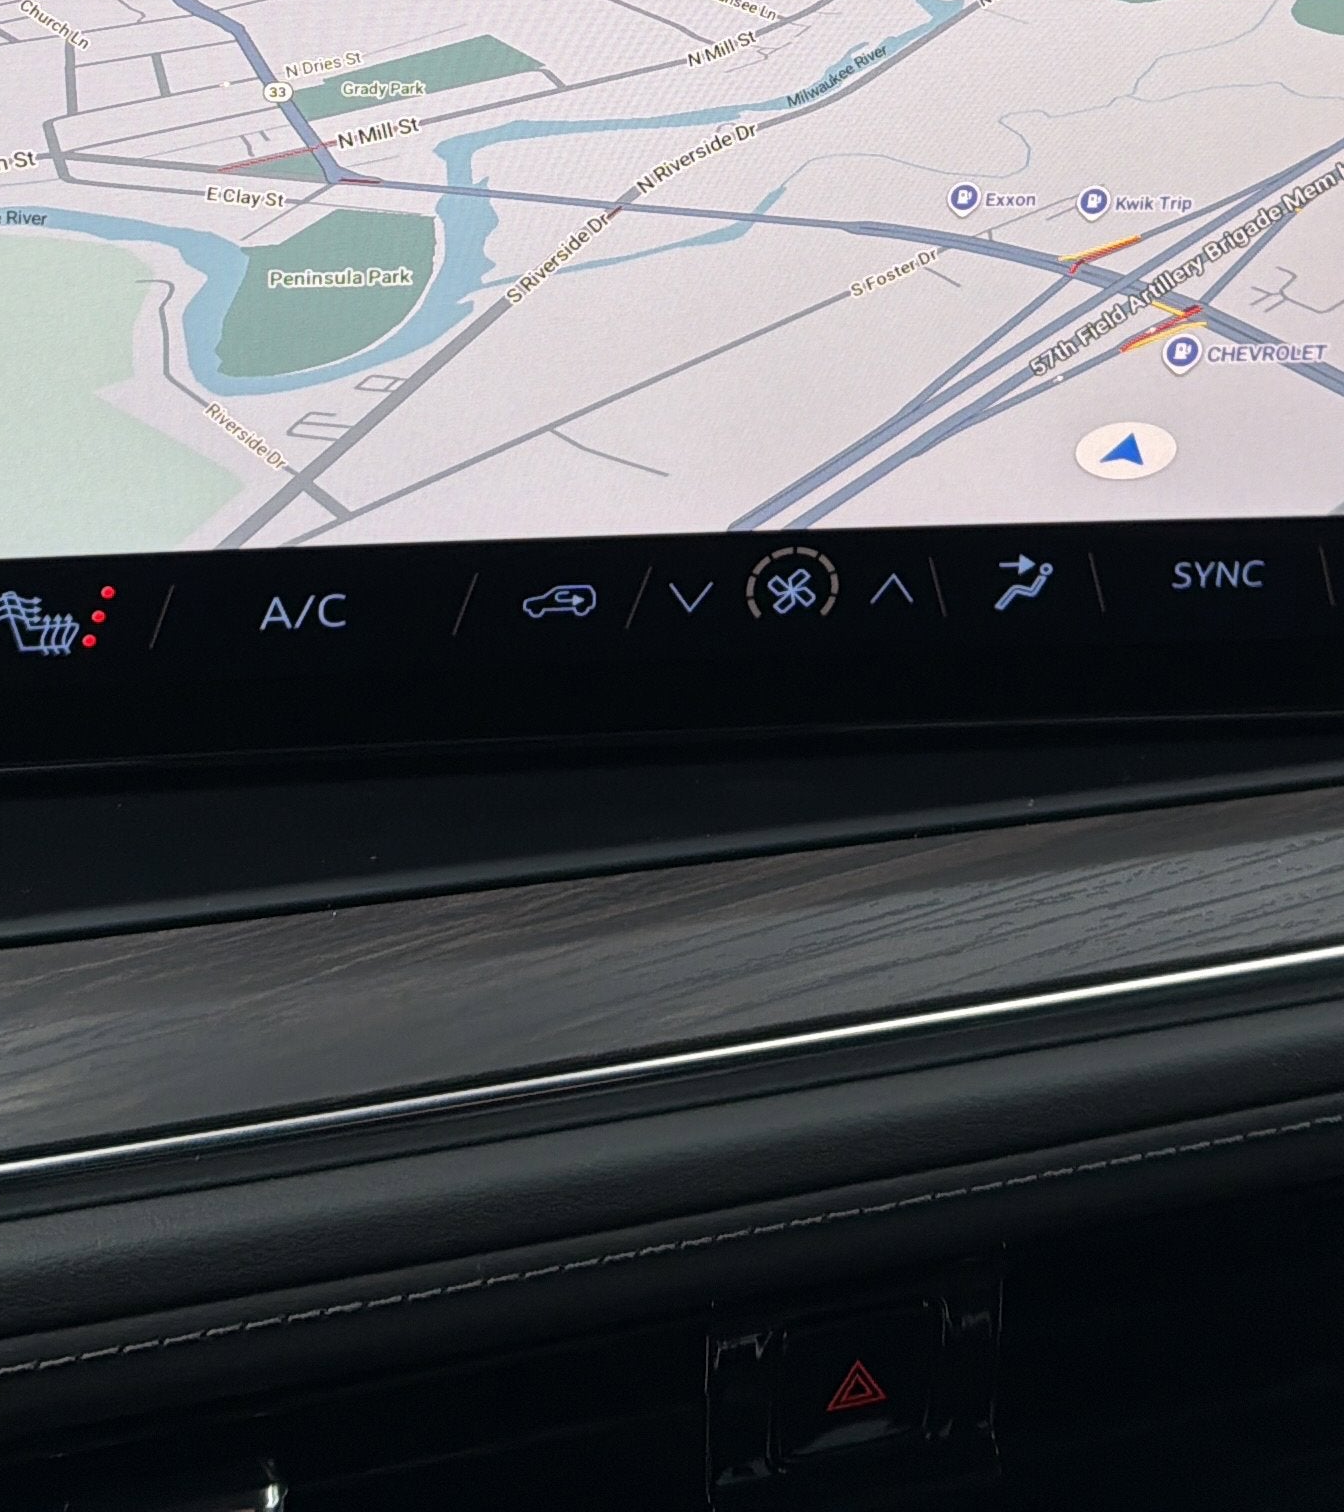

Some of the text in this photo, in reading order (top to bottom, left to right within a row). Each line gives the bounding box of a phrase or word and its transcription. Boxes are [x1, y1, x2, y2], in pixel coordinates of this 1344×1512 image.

[20, 0, 89, 50] Church Ln
[760, 5, 776, 21] Ln
[687, 31, 757, 67] N Mill St
[285, 53, 362, 78] N Dries St
[787, 45, 888, 108] Milwaukee River
[268, 87, 287, 98] 33
[343, 82, 424, 98] Grady Park
[338, 118, 419, 149] N Mill St
[13, 151, 36, 167] St
[637, 123, 757, 194] N Riverside Dr
[207, 188, 284, 208] E Clay St
[985, 192, 1036, 207] Exxon
[1115, 196, 1192, 214] Kwik Trip
[6, 210, 48, 227] River
[507, 213, 609, 304] S Riverside Dr
[270, 268, 413, 287] Peninsula Park
[850, 248, 938, 298] S Foster Dr
[1030, 342, 1078, 377] 57th
[1077, 307, 1126, 346] Field
[1129, 253, 1205, 314] Artillery
[1205, 206, 1281, 260] Brigade
[1282, 171, 1336, 214] Mem
[1208, 344, 1327, 363] CHEVROLET
[206, 403, 287, 470] Riverside Dr
[1171, 560, 1266, 590] SYNC
[259, 594, 348, 631] A/C
